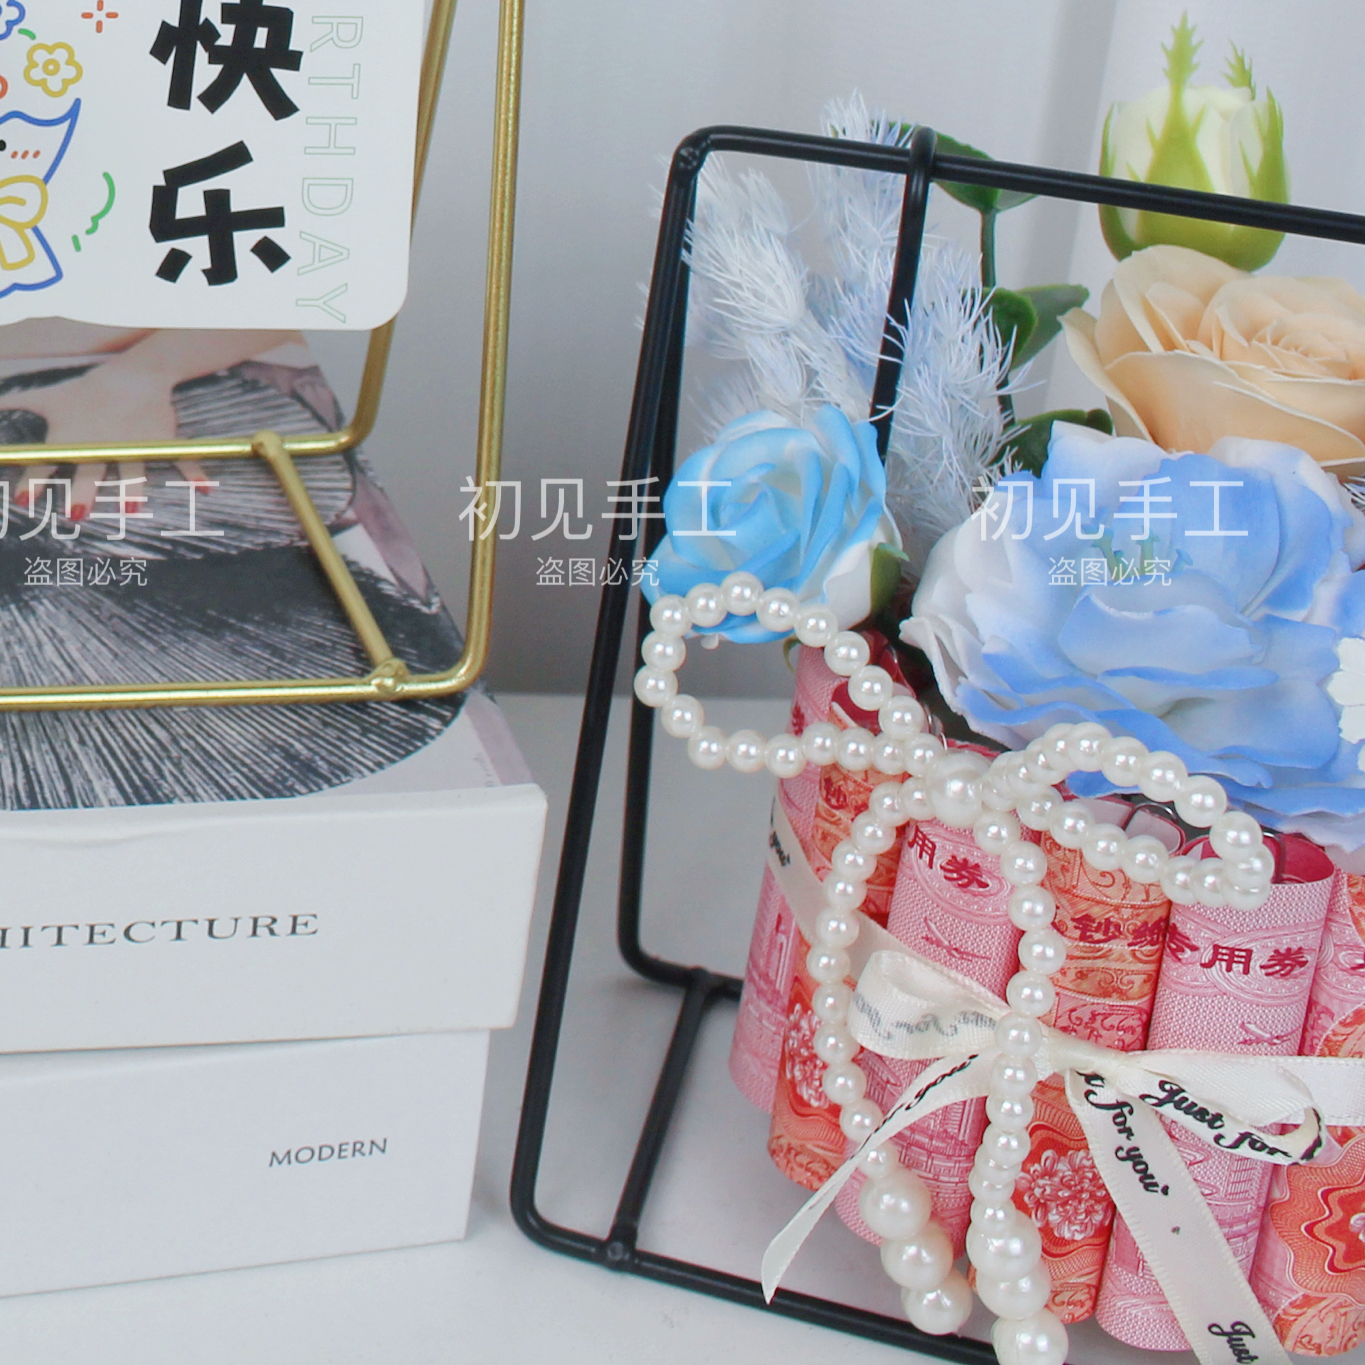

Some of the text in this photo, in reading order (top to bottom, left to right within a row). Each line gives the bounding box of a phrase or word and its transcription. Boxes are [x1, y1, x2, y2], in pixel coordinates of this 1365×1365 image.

[268, 1137, 388, 1168] MODERN
[1084, 1088, 1134, 1142] for
[1115, 1144, 1164, 1195] you
[1139, 1079, 1226, 1131] Just
[1213, 1130, 1293, 1160] for
